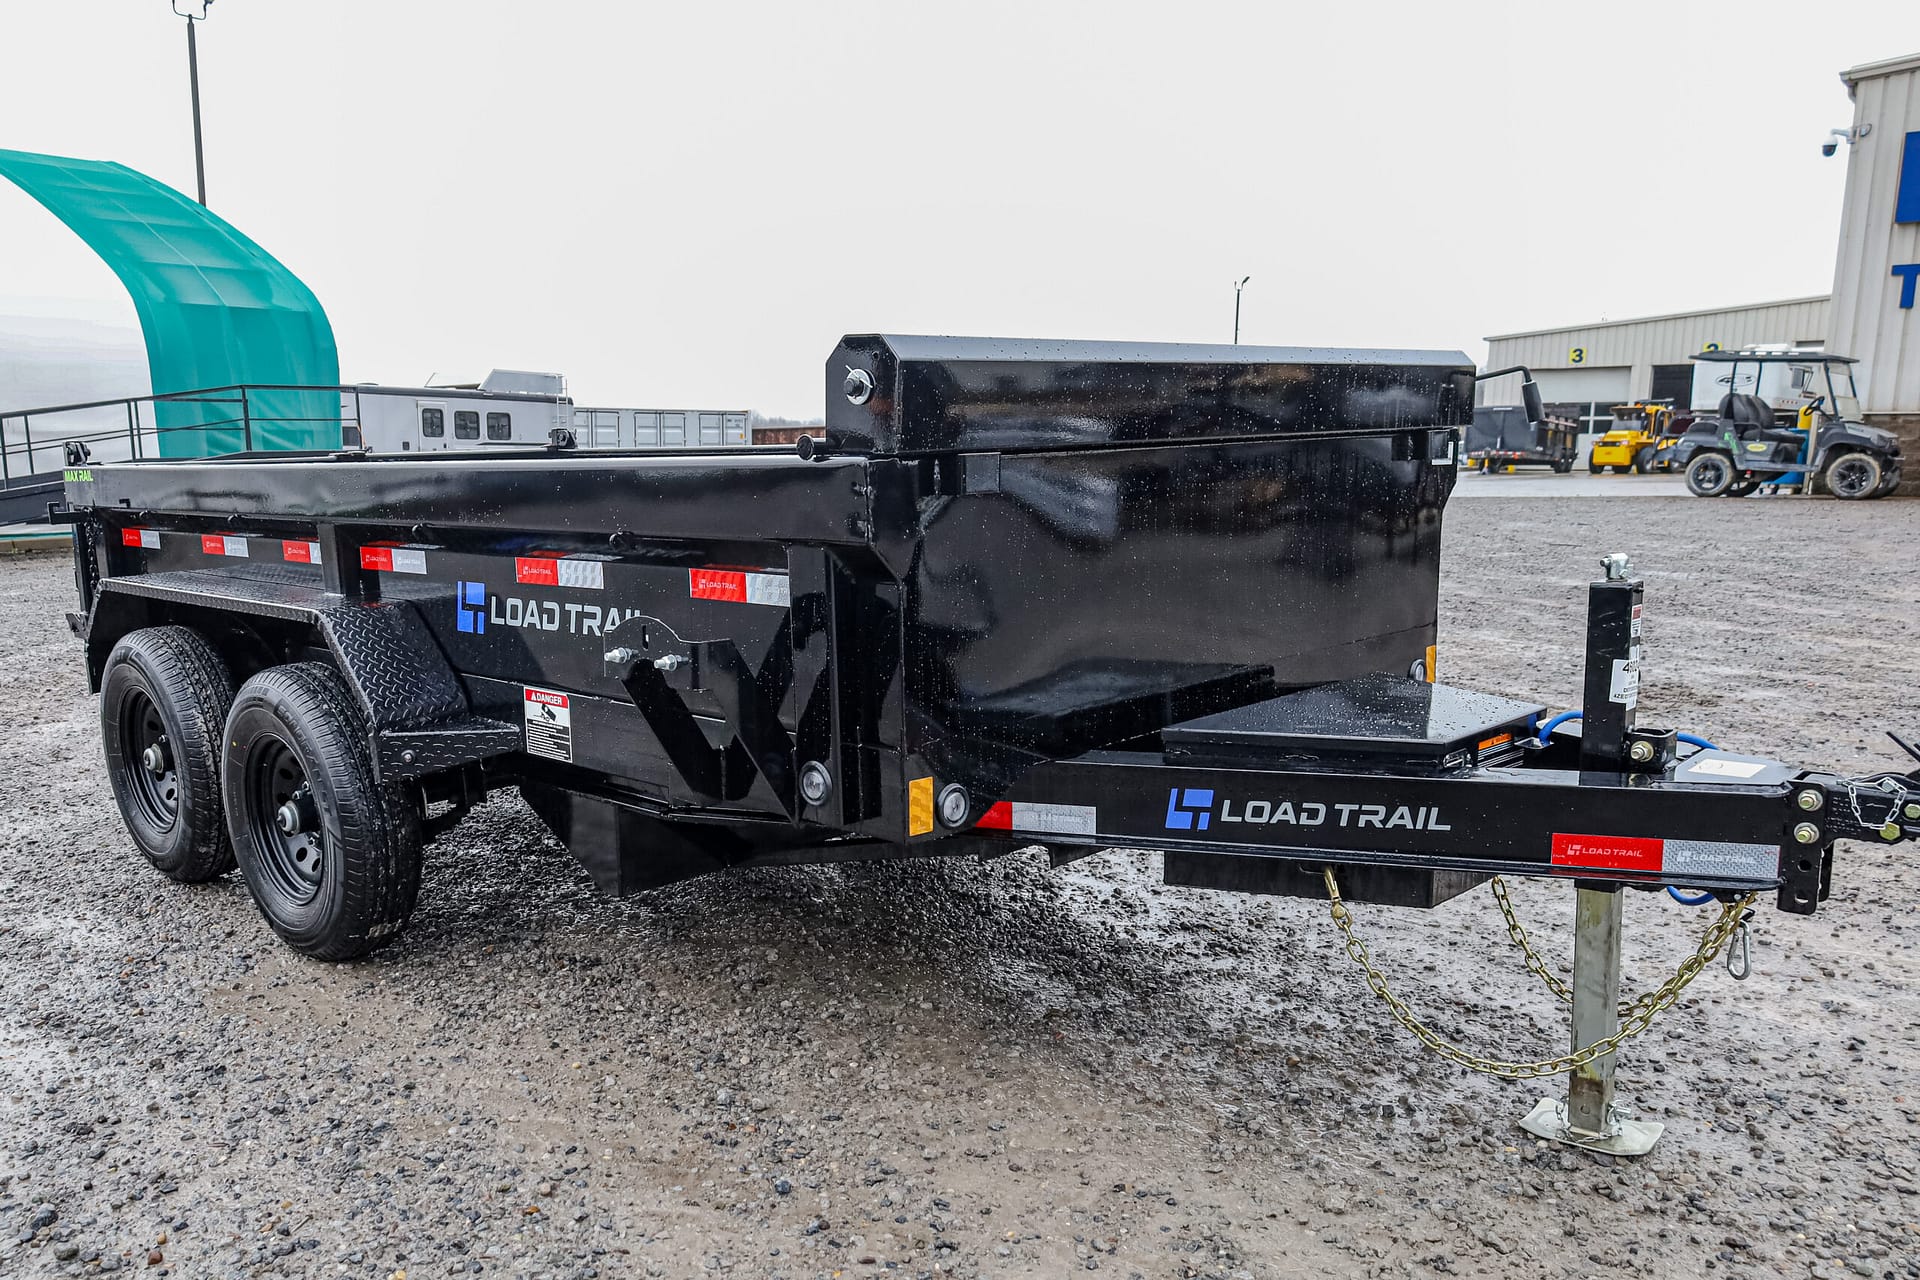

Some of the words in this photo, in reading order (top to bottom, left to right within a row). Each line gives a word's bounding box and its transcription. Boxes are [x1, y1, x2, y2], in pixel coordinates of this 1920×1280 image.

[1571, 348, 1584, 363] 3
[64, 470, 79, 482] MAX
[79, 470, 94, 482] RAIL
[490, 595, 560, 631] LOAD
[565, 602, 641, 637] TRA
[536, 692, 563, 706] DANGER
[1220, 799, 1327, 826] LOAD
[1334, 803, 1451, 832] TRAIL
[1582, 847, 1612, 856] LOAD
[1612, 848, 1644, 858] TRAIL
